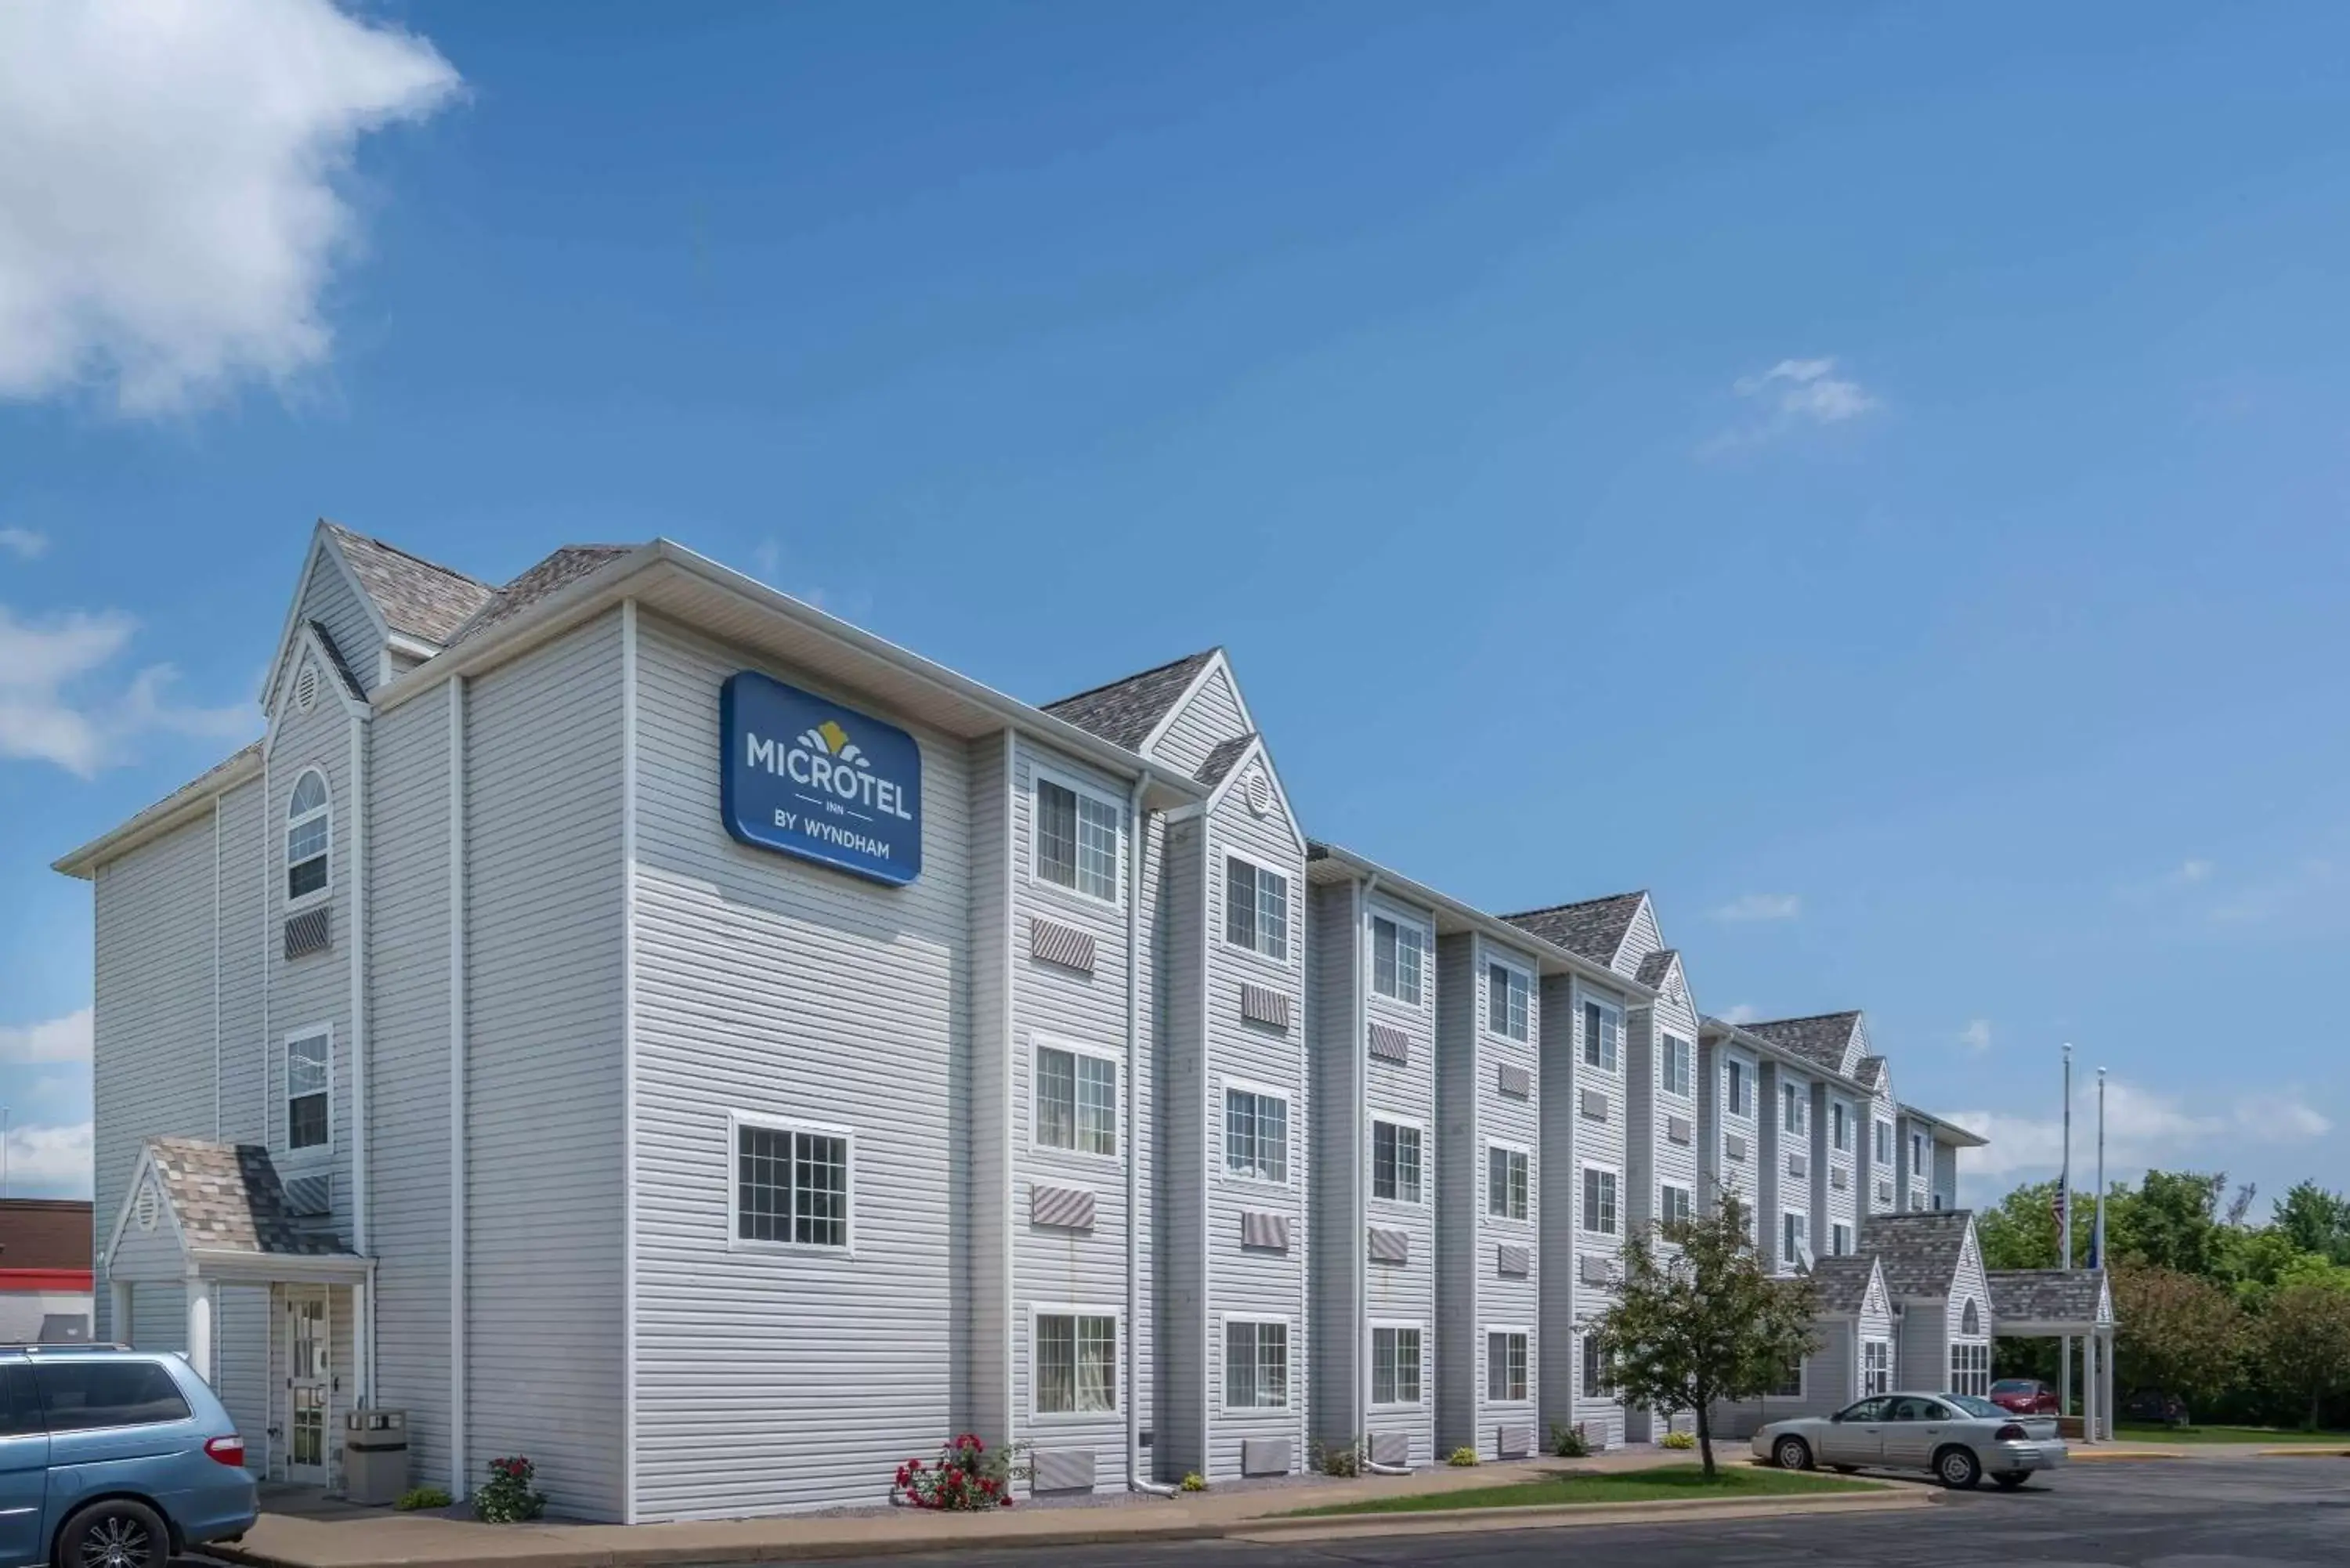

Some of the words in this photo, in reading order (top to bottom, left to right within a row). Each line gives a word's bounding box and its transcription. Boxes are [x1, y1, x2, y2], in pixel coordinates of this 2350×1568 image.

[747, 732, 912, 820] MICROTEL
[775, 808, 797, 830] BY
[804, 818, 890, 859] WYNDHAM
[826, 801, 844, 815] INN
